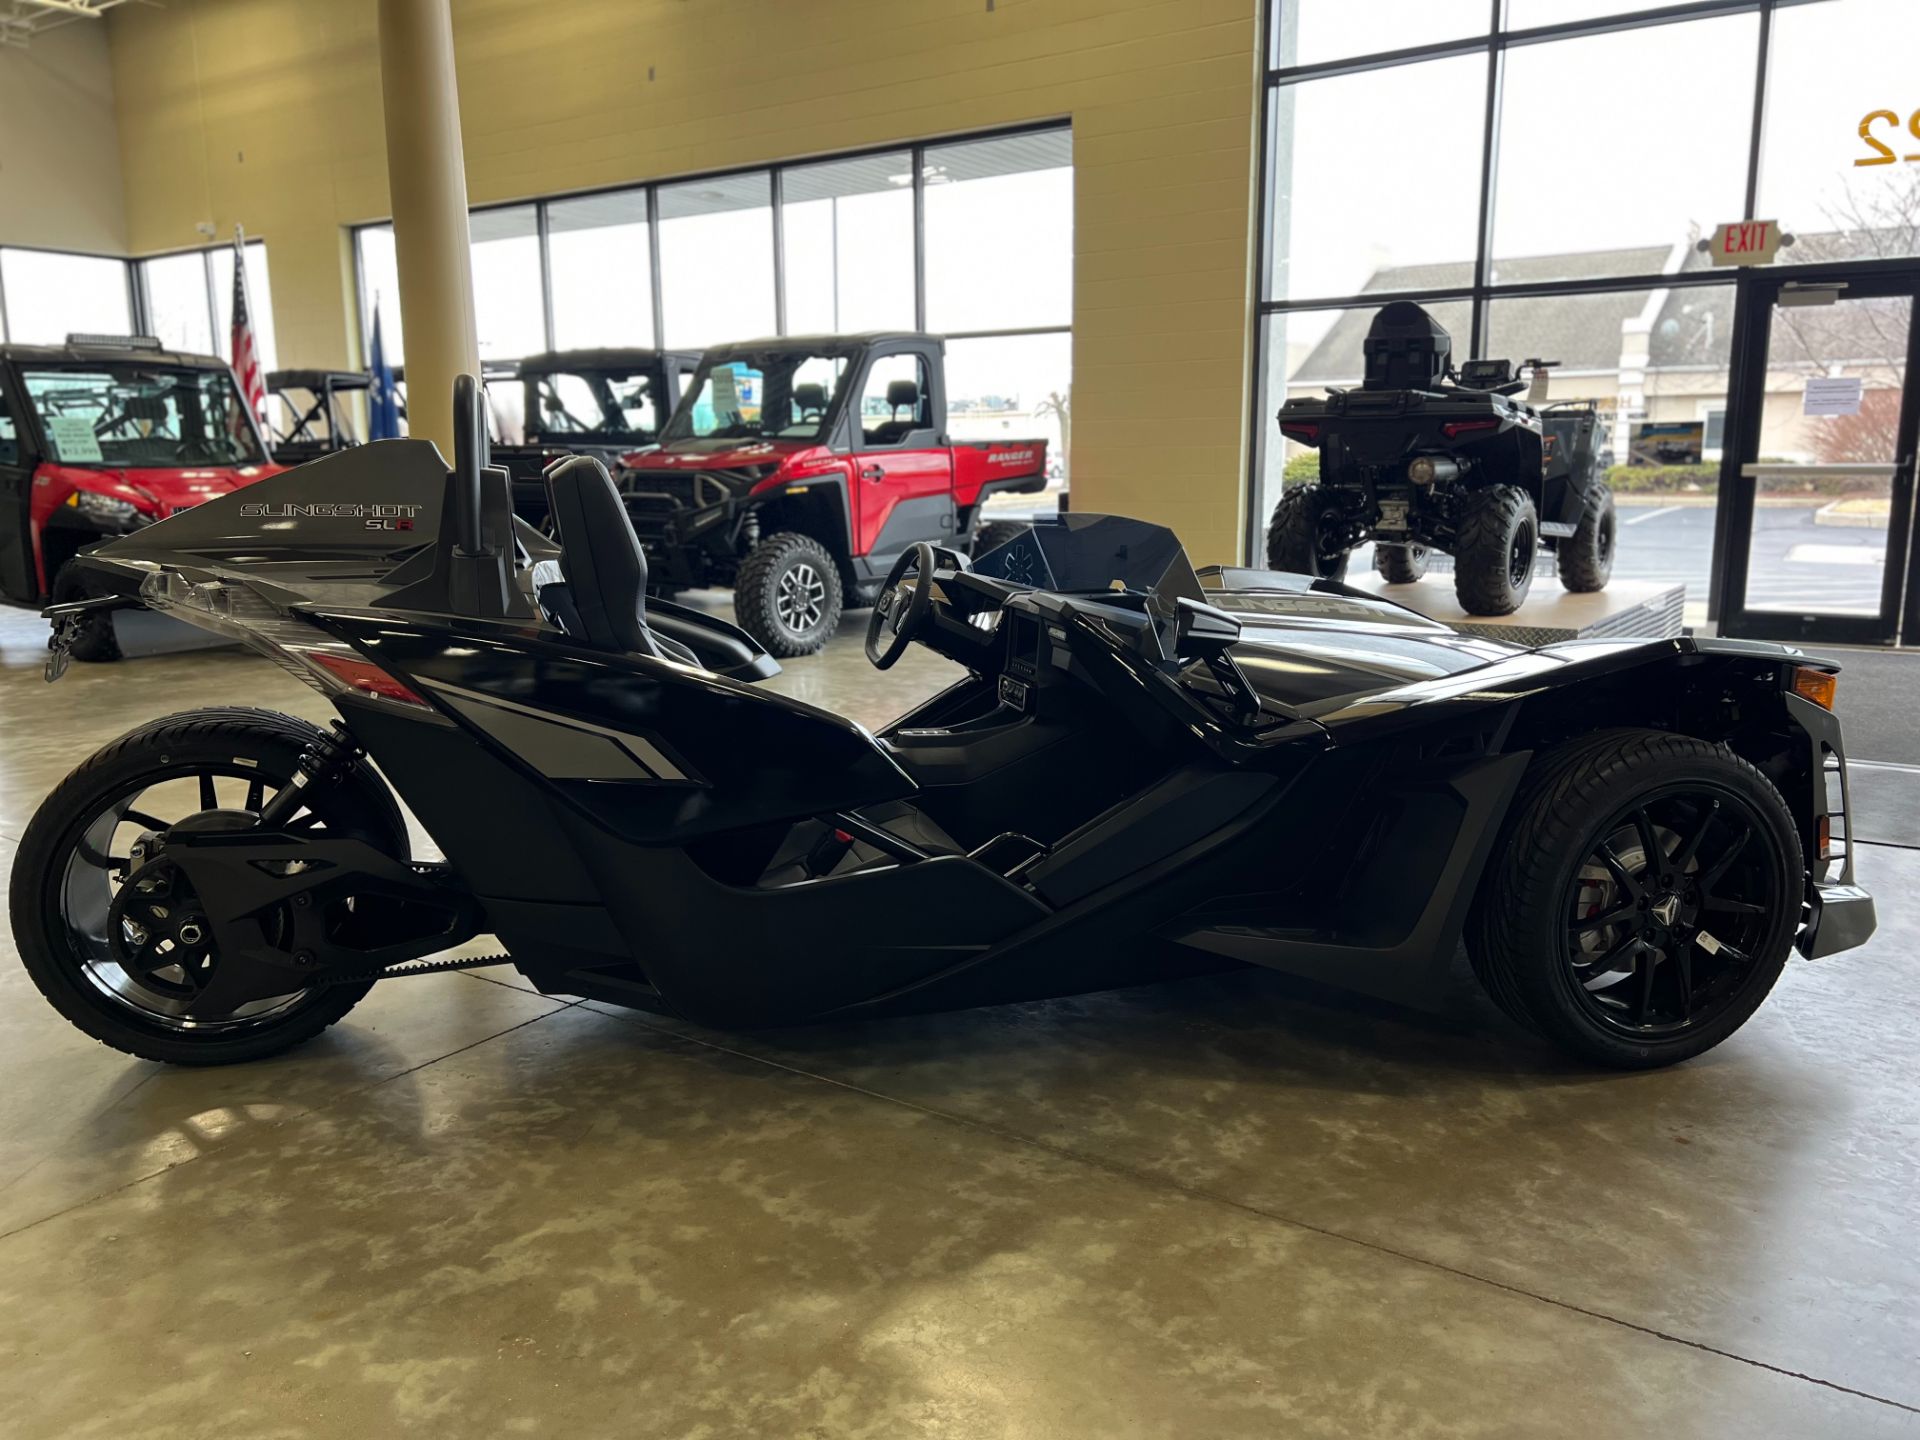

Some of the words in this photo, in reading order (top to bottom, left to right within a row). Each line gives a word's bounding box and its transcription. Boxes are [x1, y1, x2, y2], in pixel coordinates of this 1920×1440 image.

[1724, 224, 1769, 253] EXIT
[987, 450, 1033, 464] RANGER
[240, 503, 423, 517] SLINGSHOT
[365, 519, 414, 531] SLR
